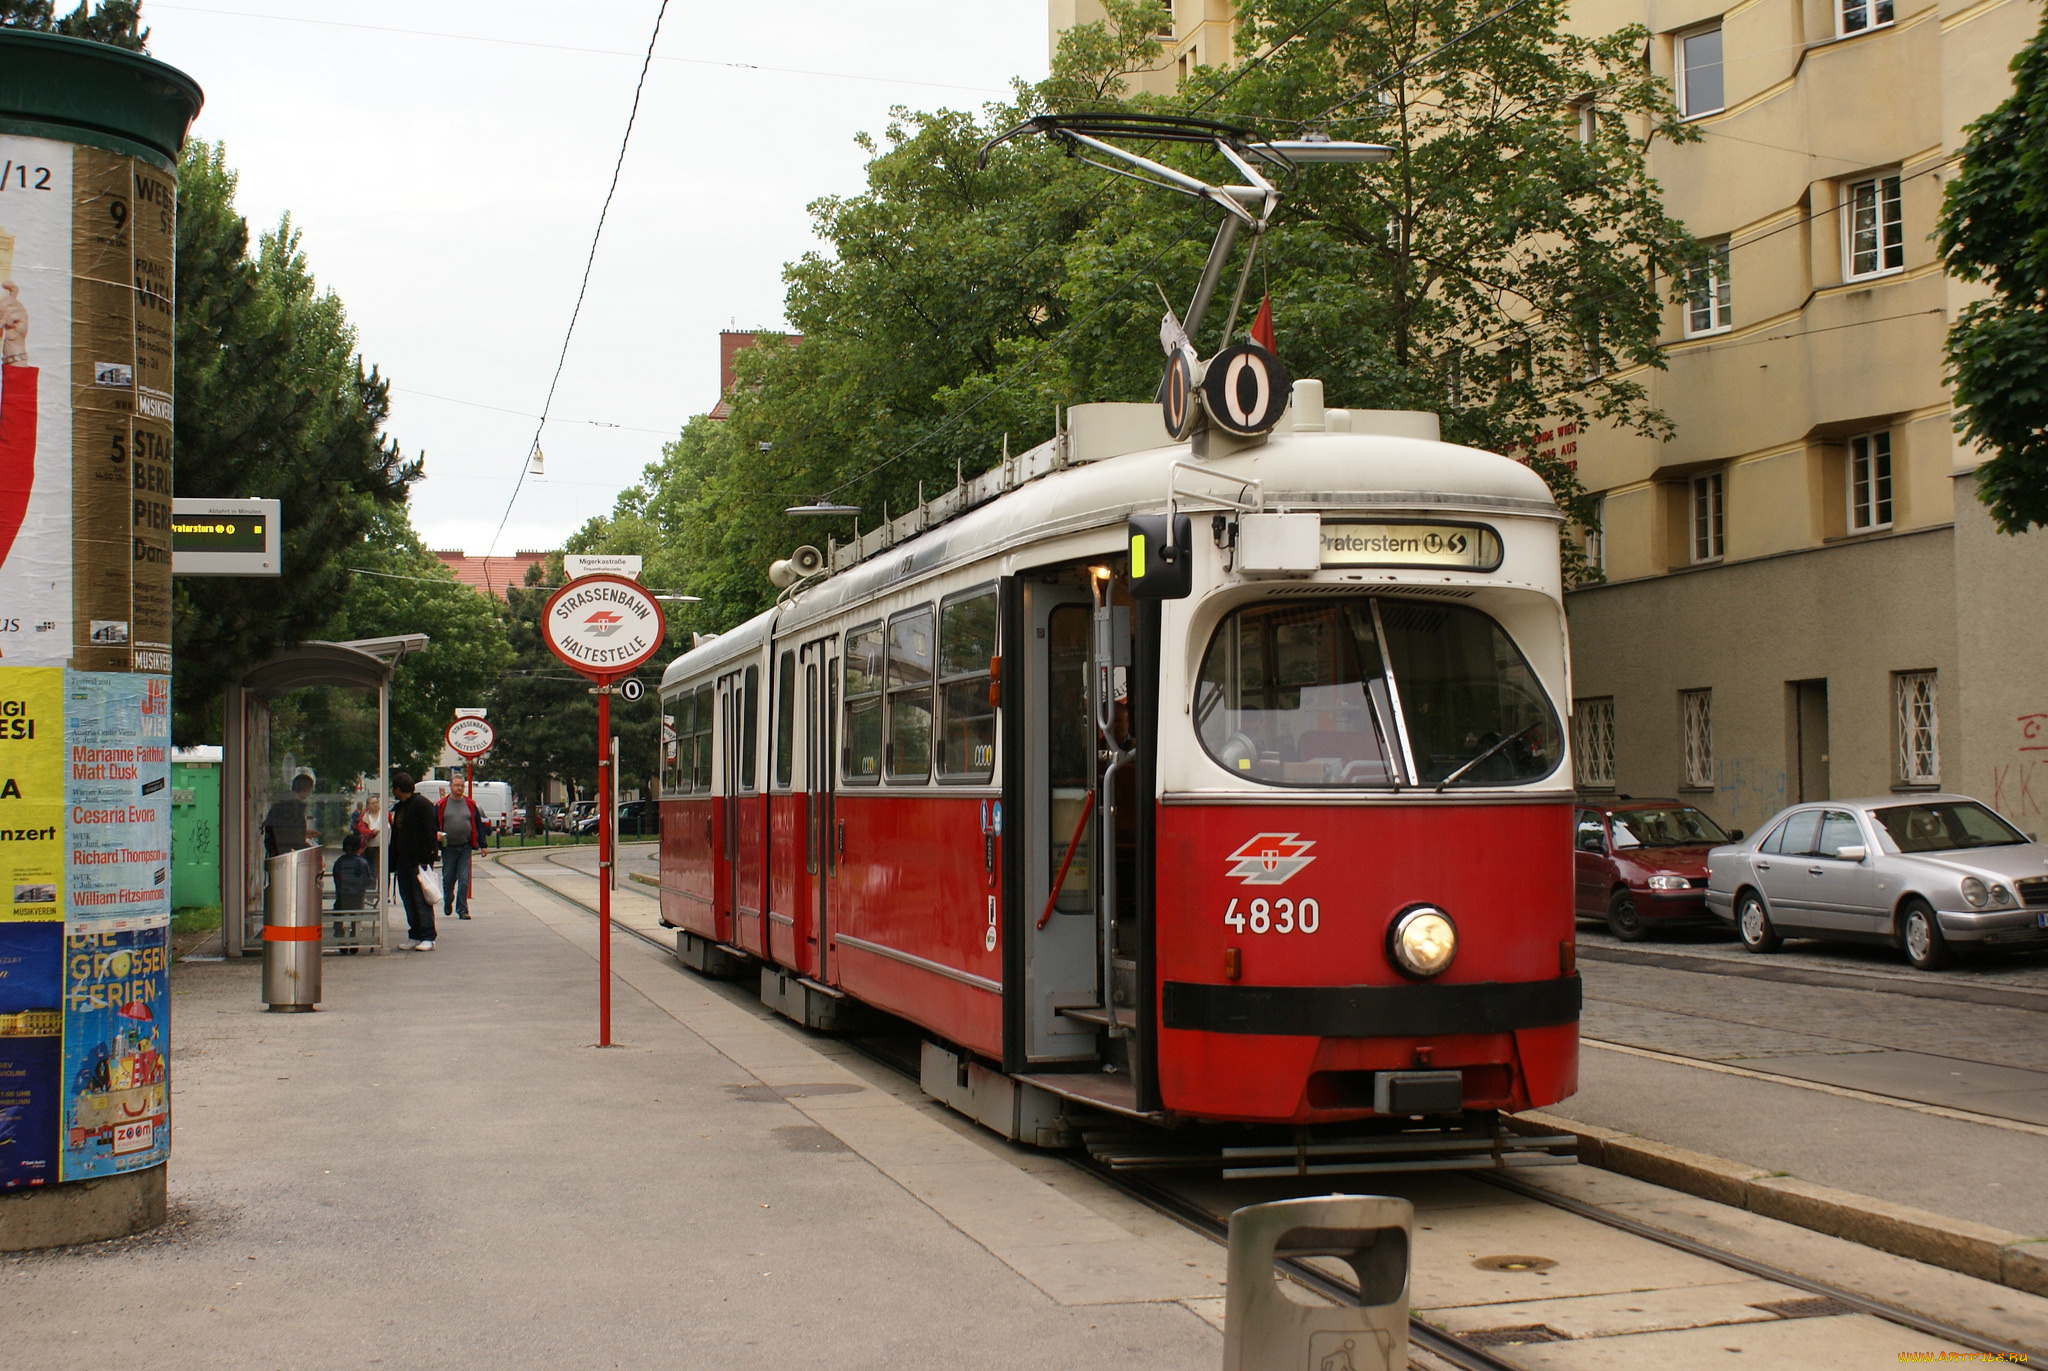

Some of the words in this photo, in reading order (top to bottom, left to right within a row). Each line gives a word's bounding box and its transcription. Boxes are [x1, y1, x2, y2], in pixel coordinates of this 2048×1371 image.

[110, 201, 127, 228] 9
[136, 258, 165, 280] FRANZ
[1557, 424, 1577, 438] WIEN
[110, 435, 126, 463] 5
[1561, 441, 1577, 456] AUS
[556, 588, 651, 621] STRASSENBAHN
[560, 635, 647, 663] HALTESTELLE
[0, 701, 26, 717] GI
[141, 717, 167, 737] WIEN
[73, 745, 134, 762] Marianne
[73, 763, 106, 780] Matt
[108, 763, 138, 780] Dusk
[73, 805, 126, 825] Cesaria
[127, 805, 155, 823] Evora
[73, 848, 119, 866] Richard
[120, 848, 161, 865] Thompson
[73, 889, 117, 907] William
[118, 887, 165, 905] Fitzsimmons
[13, 906, 57, 916] MUSIKVEREIN
[1223, 897, 1319, 934] 4830
[71, 978, 156, 1012] FERIEN
